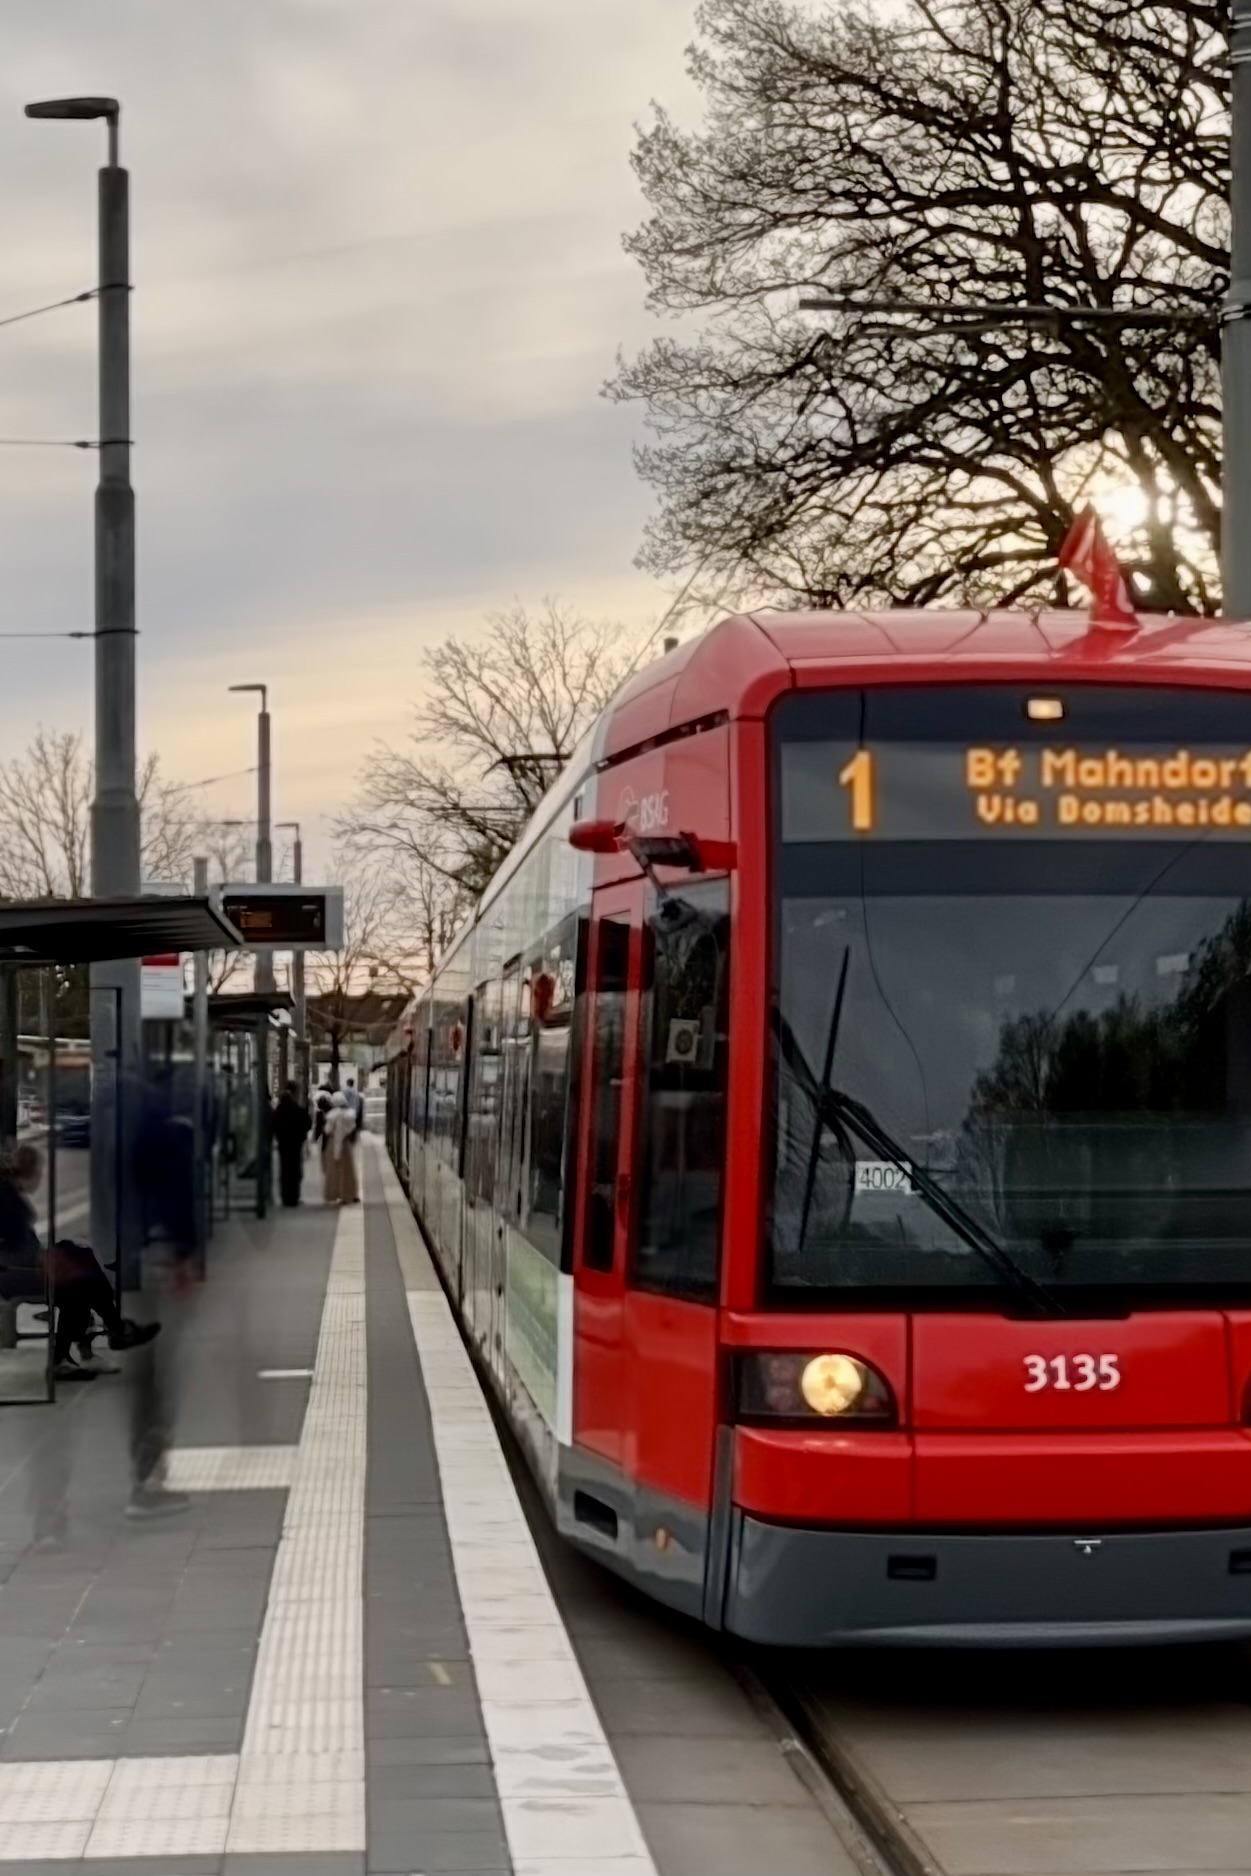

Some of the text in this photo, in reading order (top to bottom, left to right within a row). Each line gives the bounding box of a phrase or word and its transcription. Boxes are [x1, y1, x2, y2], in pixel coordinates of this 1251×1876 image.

[966, 748, 1021, 787] Bf
[839, 750, 872, 830] 1
[977, 795, 1039, 824] Via
[1023, 1353, 1121, 1391] 3135
